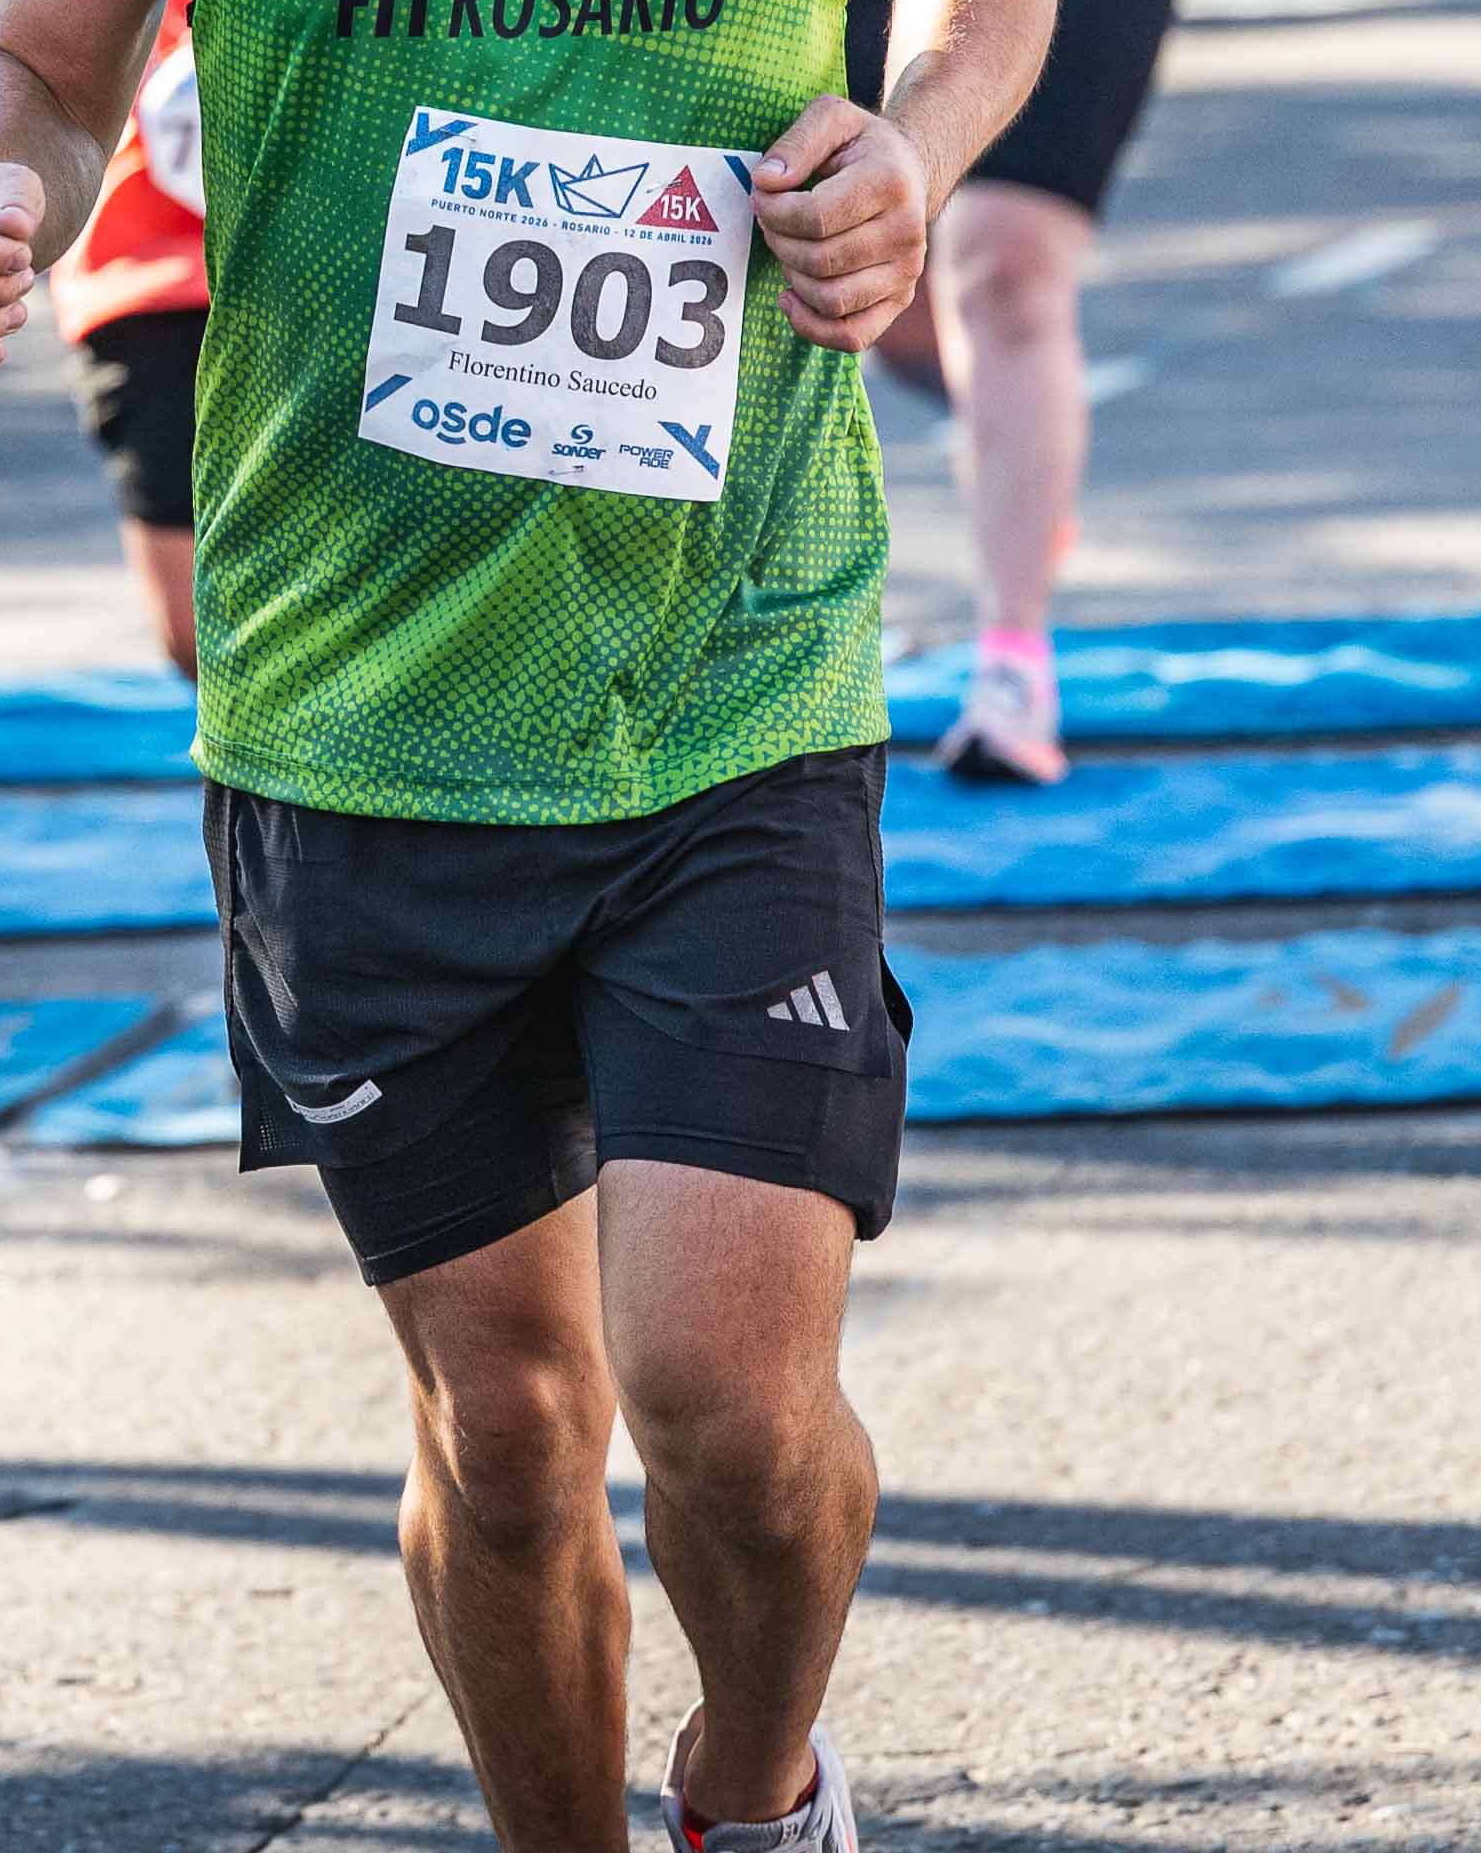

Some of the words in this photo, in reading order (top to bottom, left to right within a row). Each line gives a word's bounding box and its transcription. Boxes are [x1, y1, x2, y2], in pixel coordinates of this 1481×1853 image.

[441, 147, 541, 209] 15K
[430, 198, 476, 216] PUERTO
[479, 208, 517, 223] NORTE
[521, 215, 549, 228] 2026
[561, 221, 611, 236] ROSARIO
[624, 229, 636, 238] 12
[640, 230, 653, 240] DE
[657, 232, 686, 244] ABRIL
[689, 234, 713, 246] 2026
[659, 193, 702, 222] 15K
[393, 224, 730, 370] 1903
[448, 350, 561, 388] Florentino
[567, 369, 658, 401] Saucedo
[411, 398, 532, 449] osde
[619, 444, 675, 460] POWER
